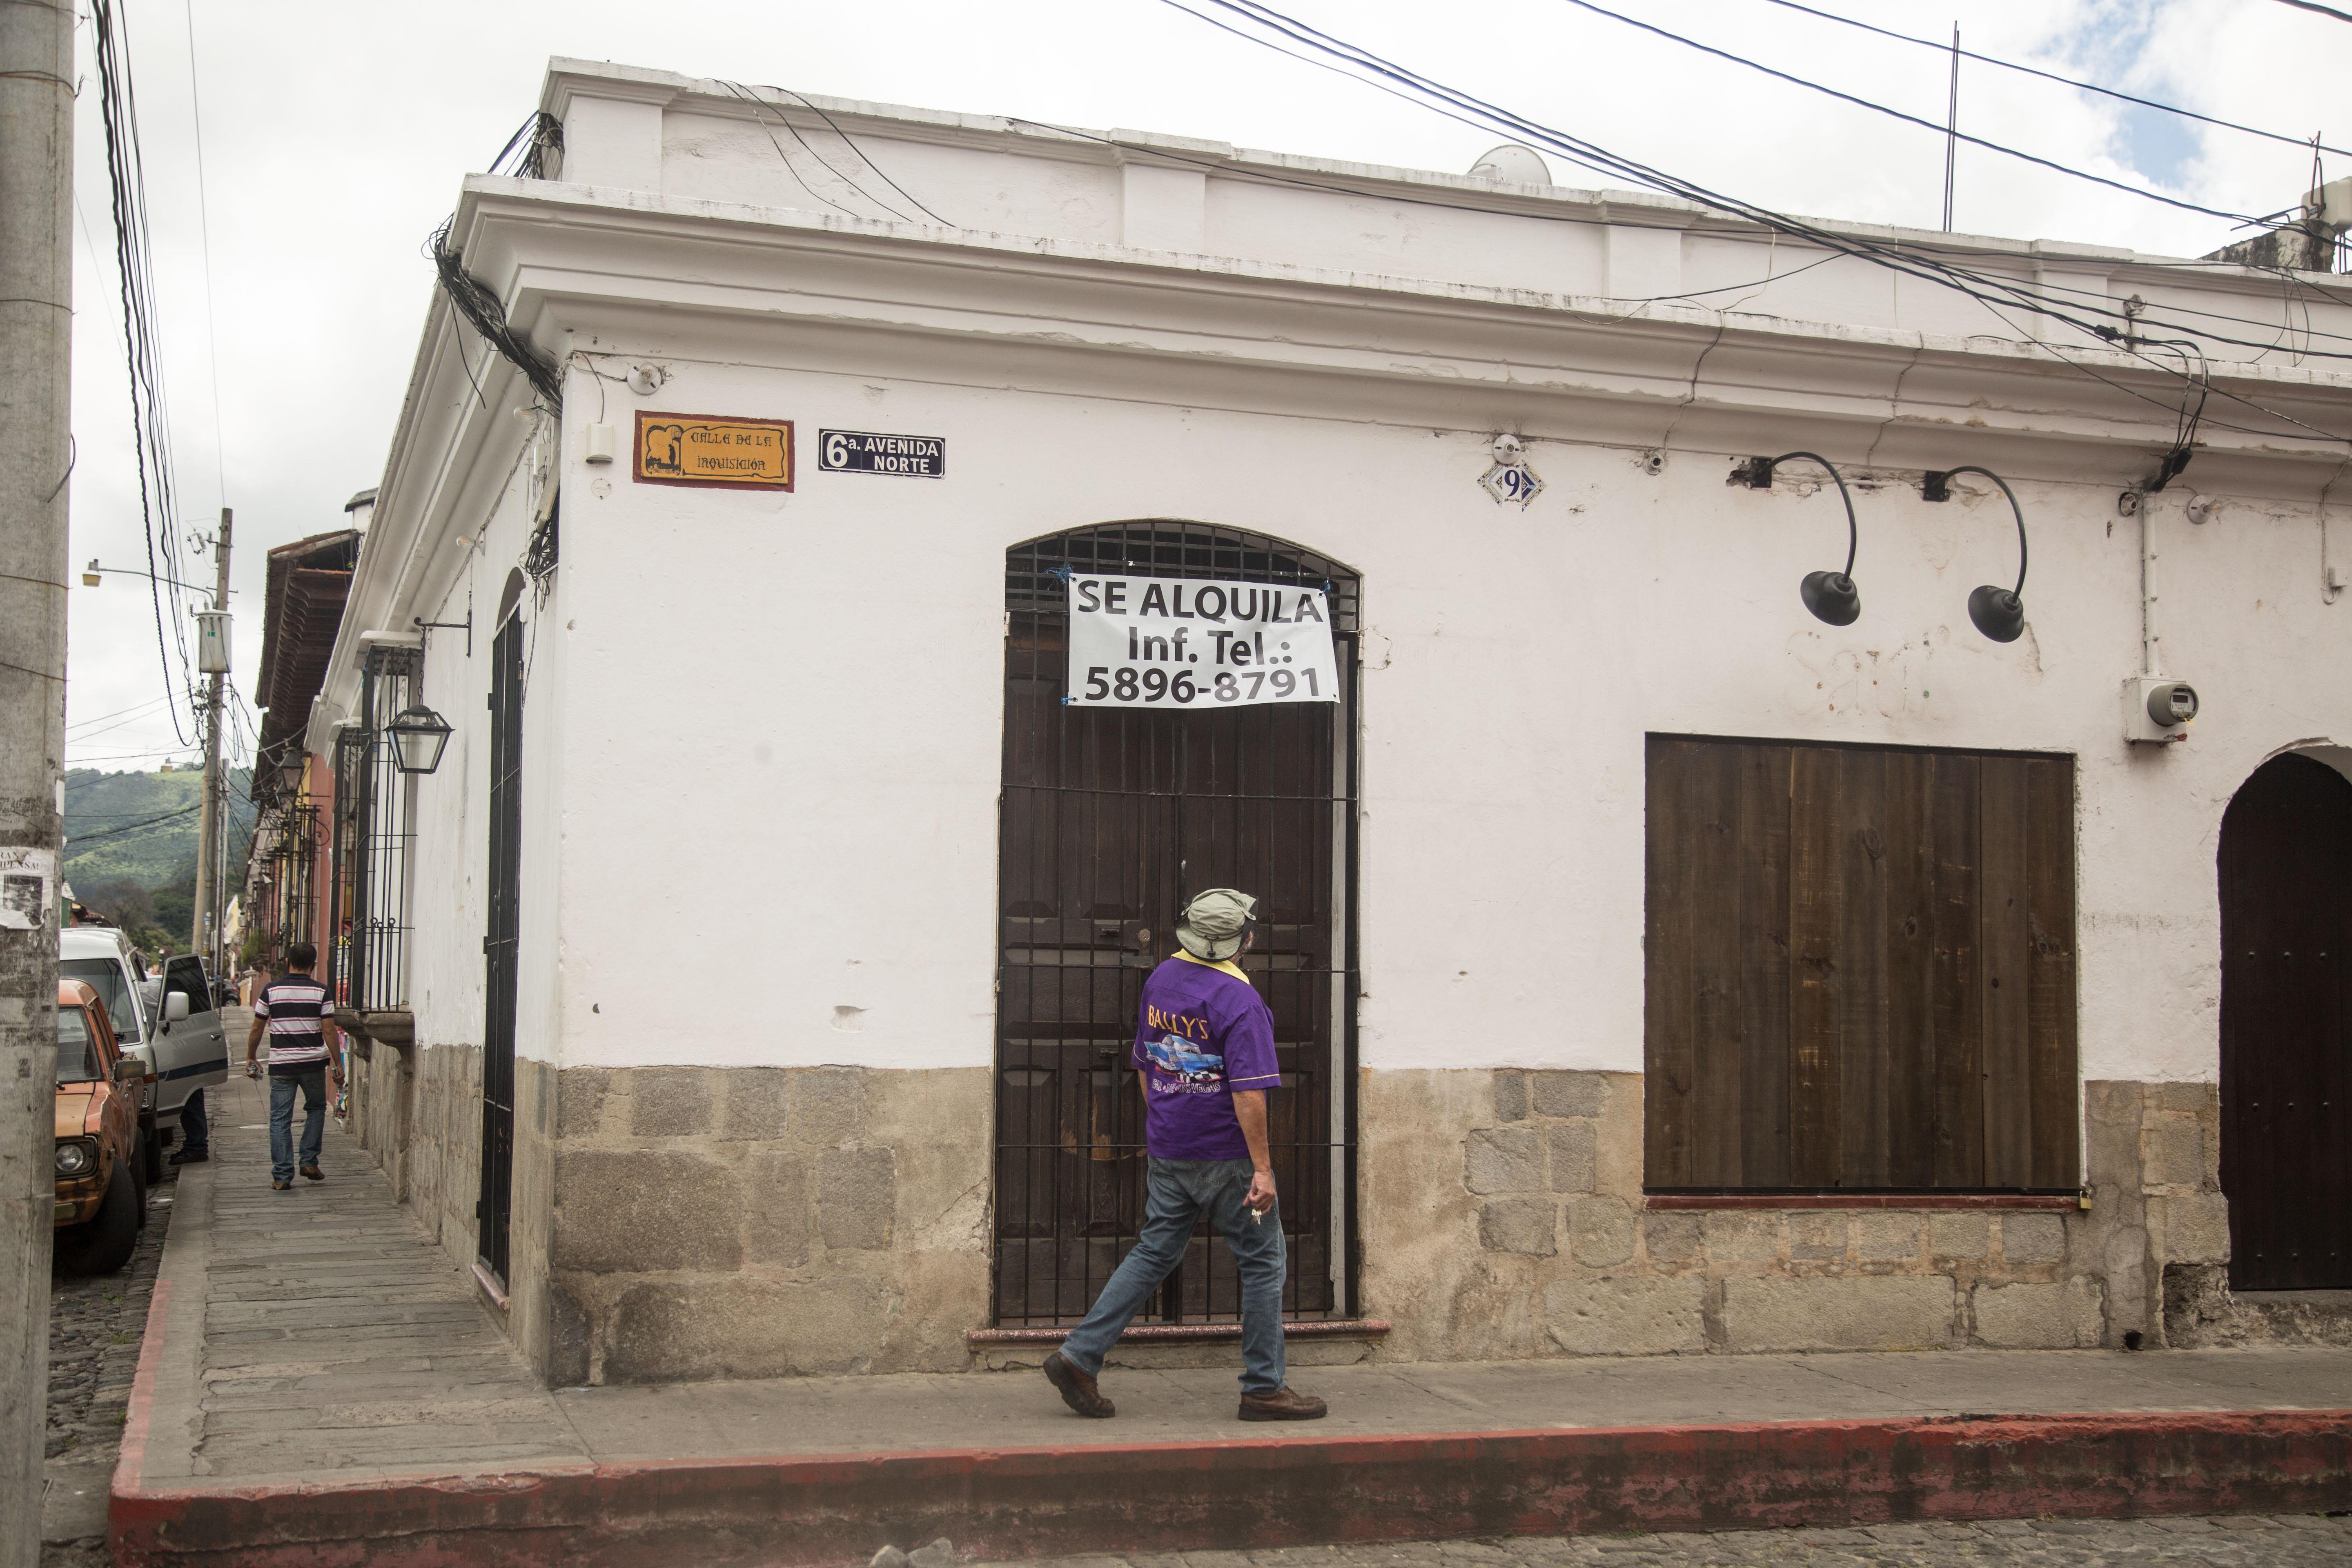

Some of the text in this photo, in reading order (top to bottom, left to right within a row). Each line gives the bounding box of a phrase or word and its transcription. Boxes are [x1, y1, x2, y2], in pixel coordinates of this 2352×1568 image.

[690, 432, 772, 447] CALLE DE LA
[864, 437, 939, 457] AVENIDA
[874, 455, 930, 473] NORTE
[1504, 470, 1520, 497] 9
[1078, 580, 1323, 625] SE ALQUILA
[1129, 626, 1292, 666] Inf. Tel.:
[1085, 666, 1319, 704] 5896-8791
[1148, 1004, 1208, 1040] BALLY'S
[1178, 1083, 1191, 1094] LAS
[1192, 1081, 1221, 1094] VEGAS
